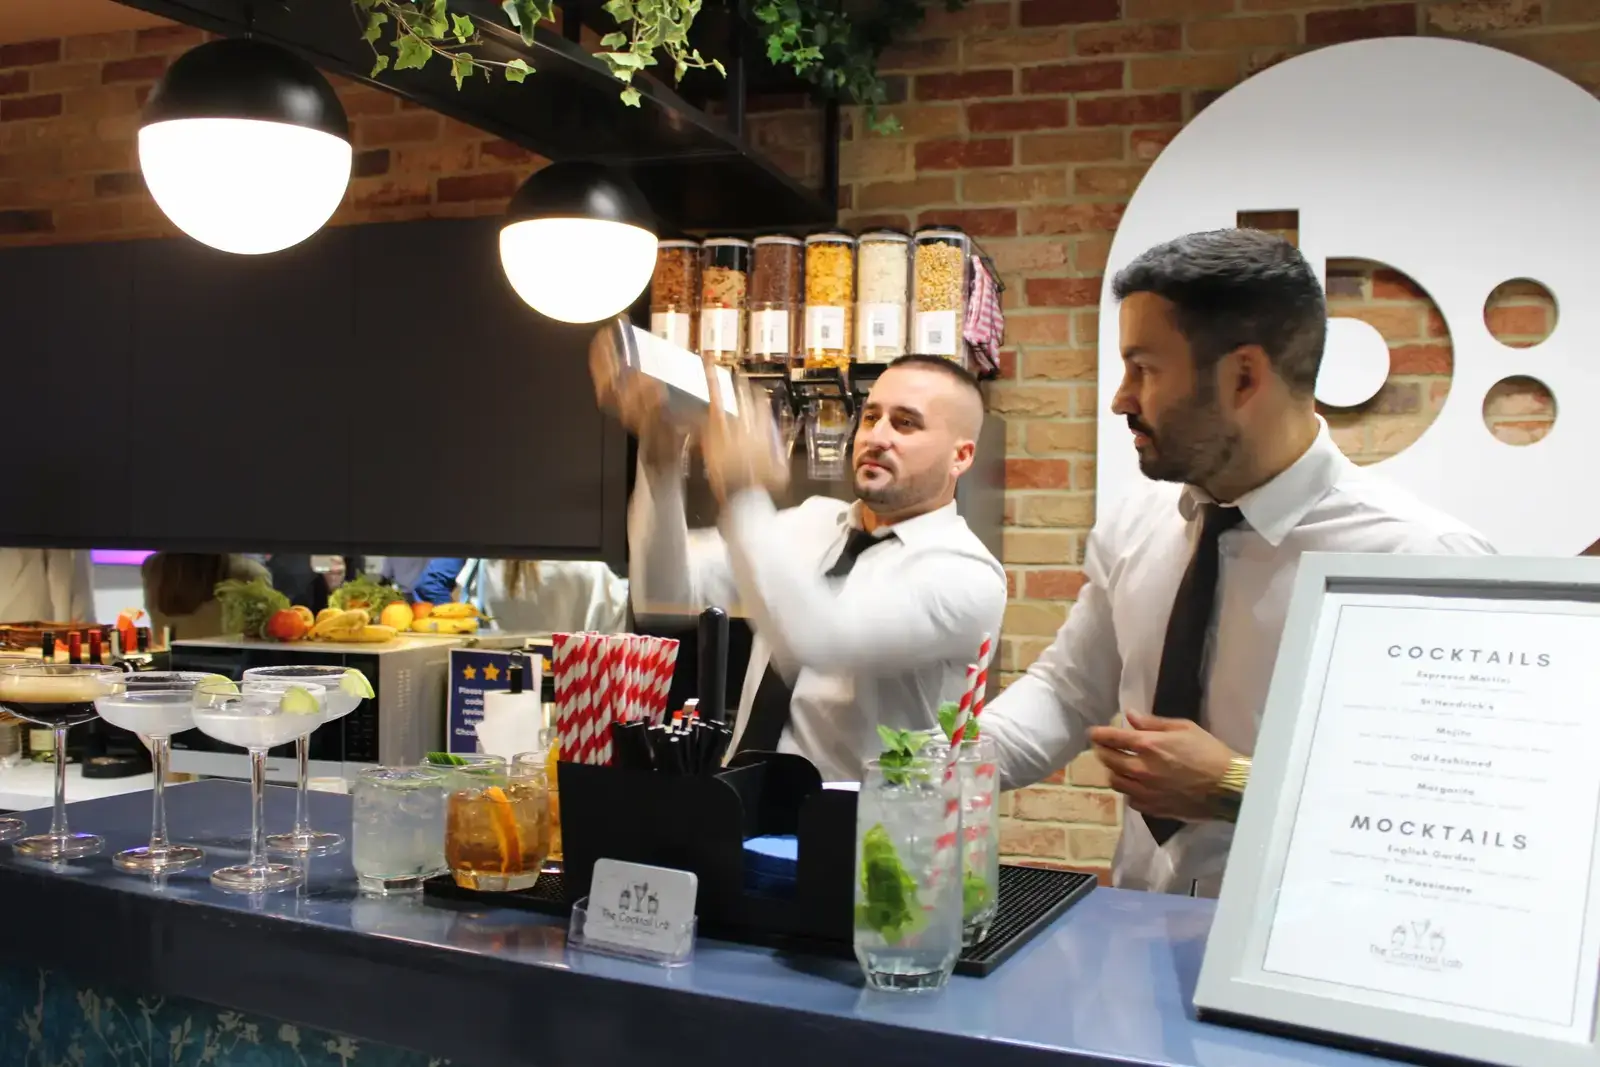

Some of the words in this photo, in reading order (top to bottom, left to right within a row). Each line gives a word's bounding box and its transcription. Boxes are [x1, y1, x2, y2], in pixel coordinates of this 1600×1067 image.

[1387, 644, 1551, 668] COCKTAILS
[1435, 726, 1472, 739] Mojito
[1410, 753, 1430, 762] Old
[1433, 754, 1492, 768] Fashioned
[1417, 782, 1475, 796] Margarita
[1350, 815, 1527, 850] MOCKTAILS
[1387, 843, 1429, 857] English
[1432, 849, 1476, 863] Garden
[1384, 874, 1404, 884] The
[602, 907, 616, 920] The
[1369, 943, 1387, 956] The
[1390, 948, 1439, 965] Cocktail
[1442, 954, 1463, 969] Lab
